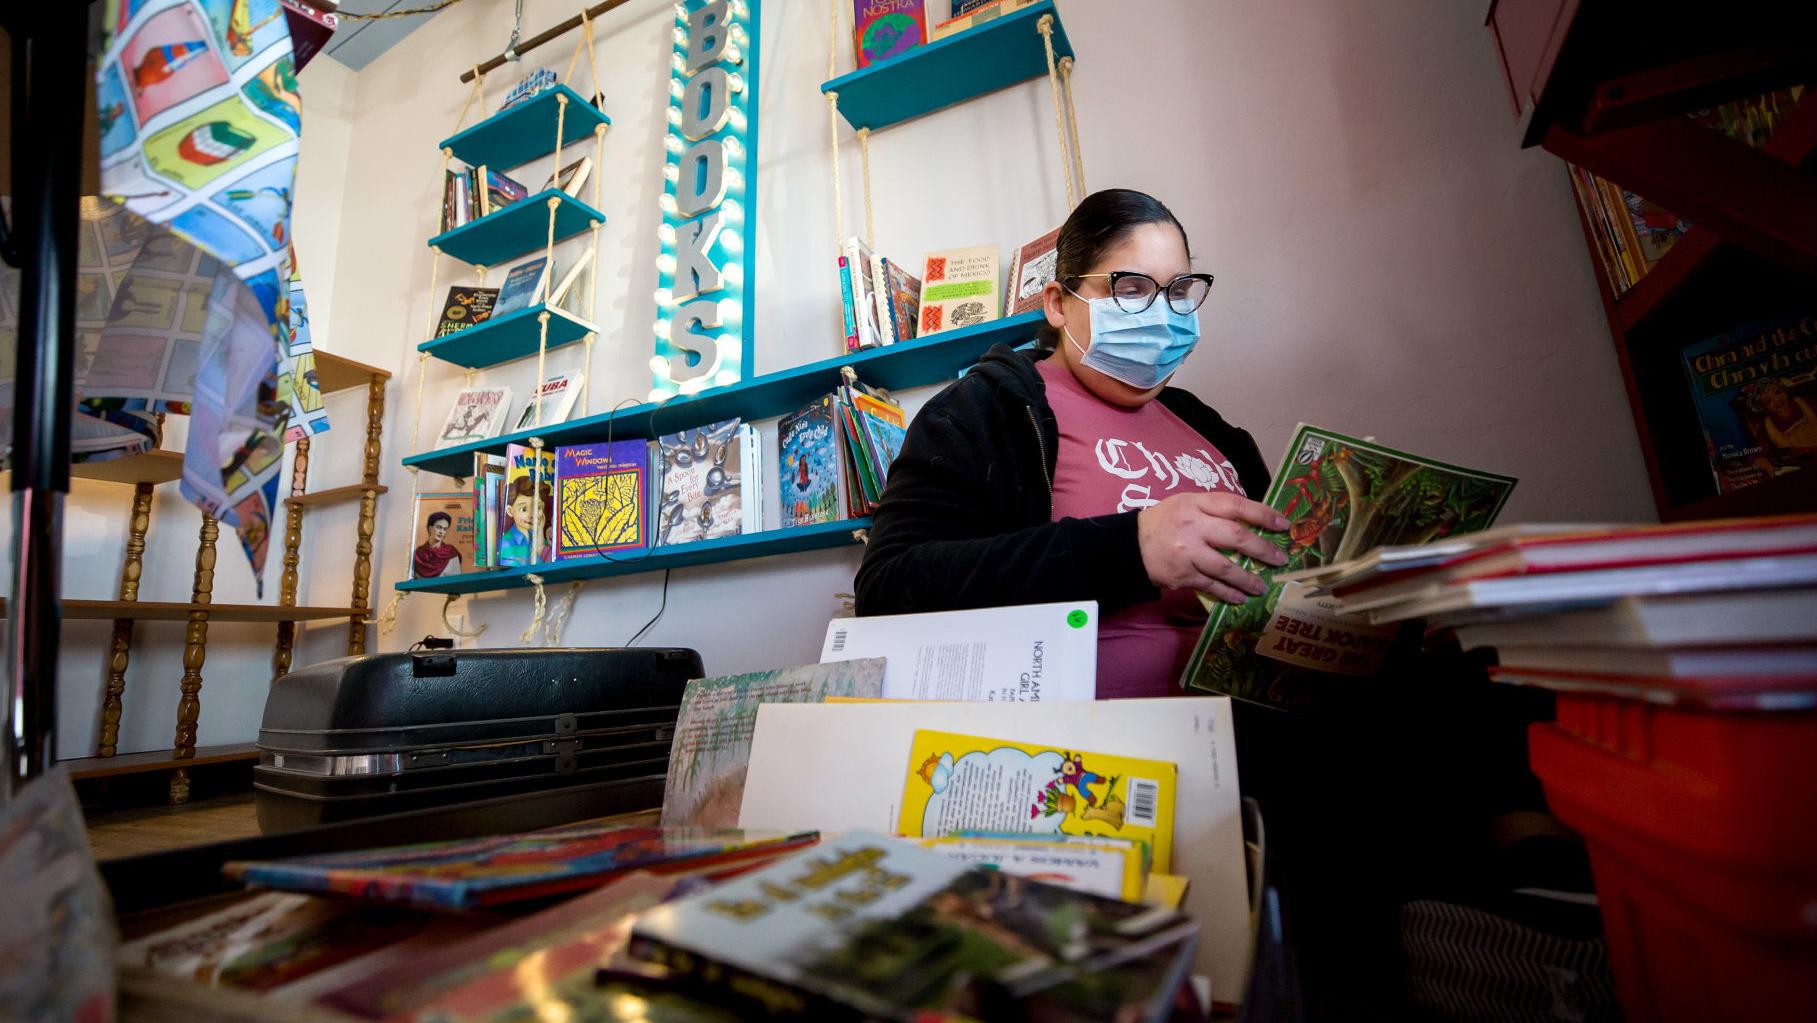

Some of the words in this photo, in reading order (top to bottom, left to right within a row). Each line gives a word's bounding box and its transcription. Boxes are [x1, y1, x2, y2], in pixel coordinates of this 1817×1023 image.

[863, 0, 914, 18] NOSTRA
[669, 0, 733, 385] BOOKS
[968, 255, 991, 264] FOOD
[960, 269, 991, 278] MEXICO
[1695, 350, 1738, 373] Clara
[1711, 366, 1756, 389] Clara
[576, 456, 612, 467] WINDOW
[1275, 615, 1323, 642] TREE
[1032, 640, 1044, 678] NORTH
[1273, 636, 1338, 662] GREAT
[1019, 672, 1031, 695] GIRL
[1030, 680, 1041, 702] AM
